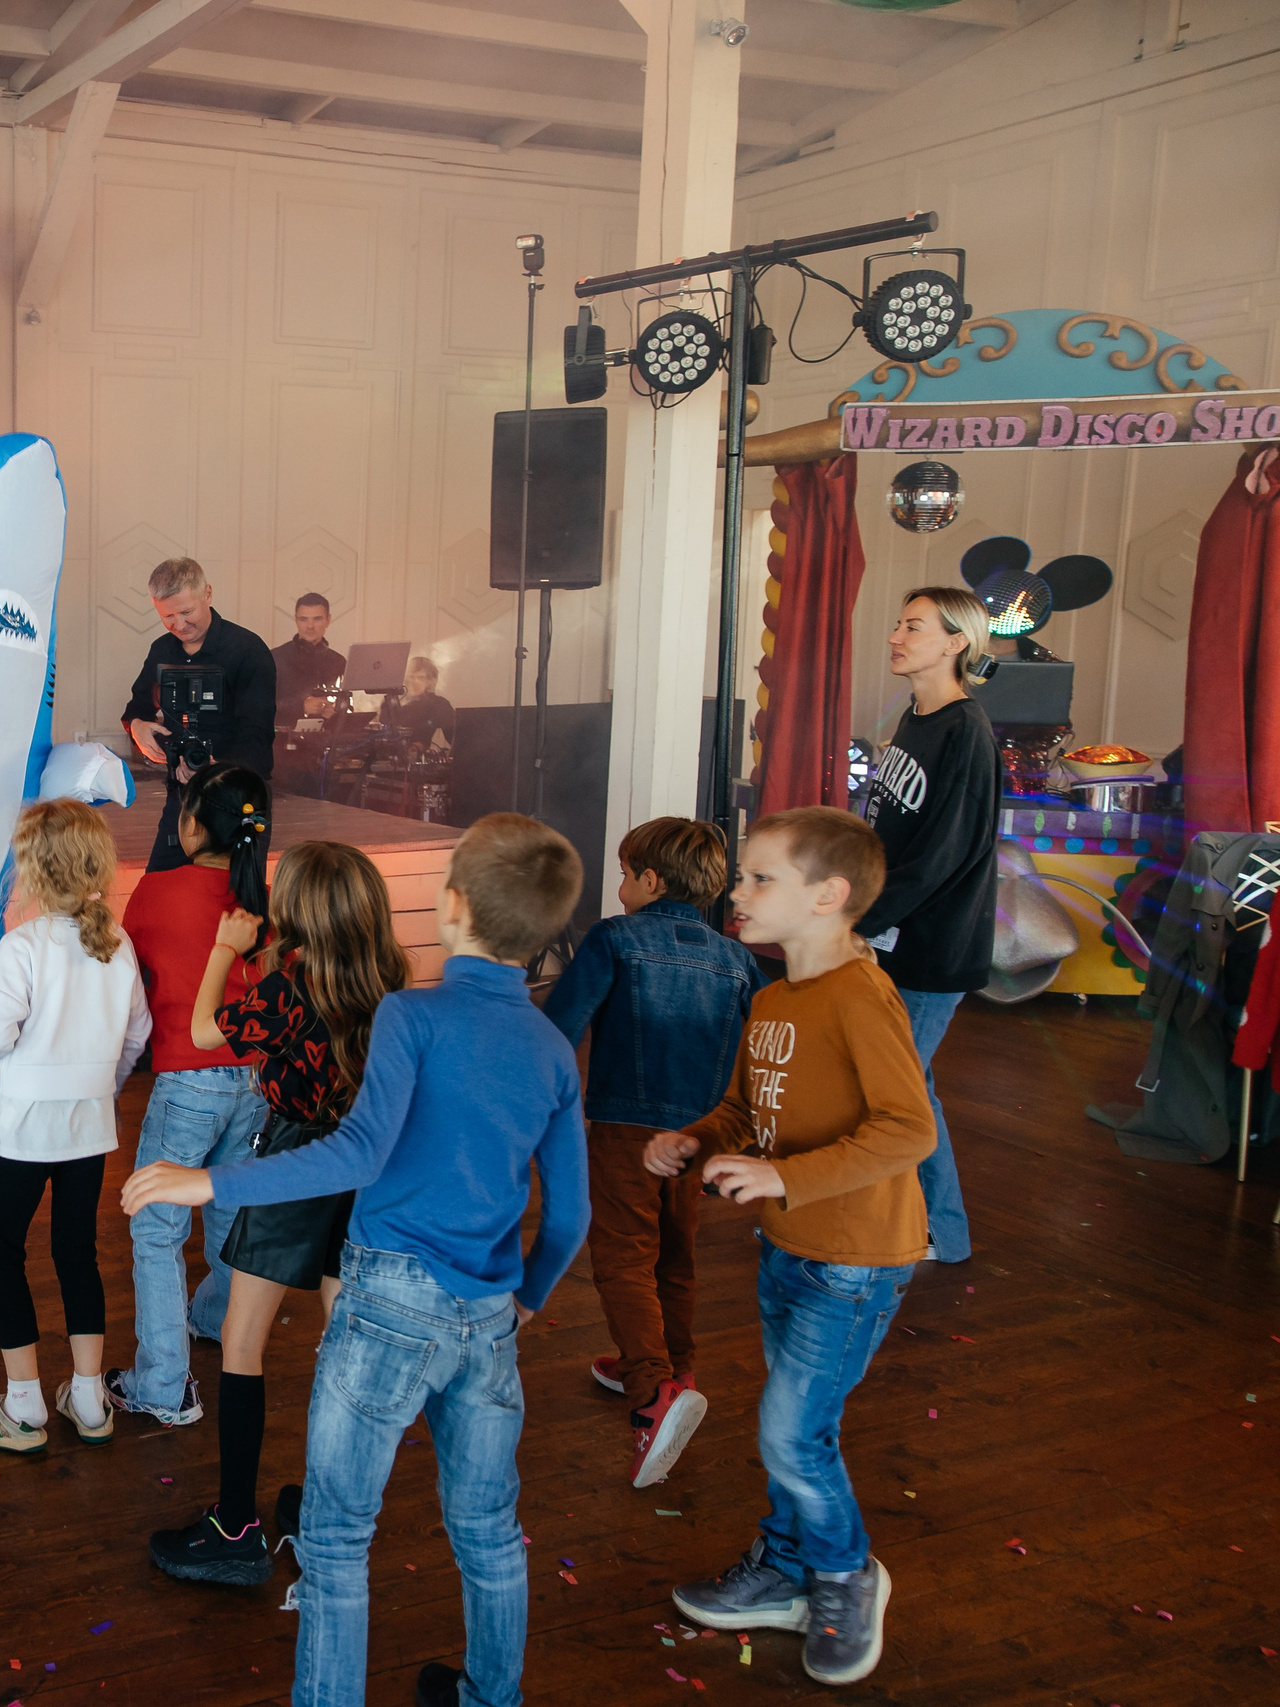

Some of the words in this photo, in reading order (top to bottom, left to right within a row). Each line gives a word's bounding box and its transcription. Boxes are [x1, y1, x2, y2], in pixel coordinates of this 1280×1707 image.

[844, 407, 1026, 448] WIZARD
[1037, 405, 1177, 447] DISCO
[873, 746, 927, 810] RVARD
